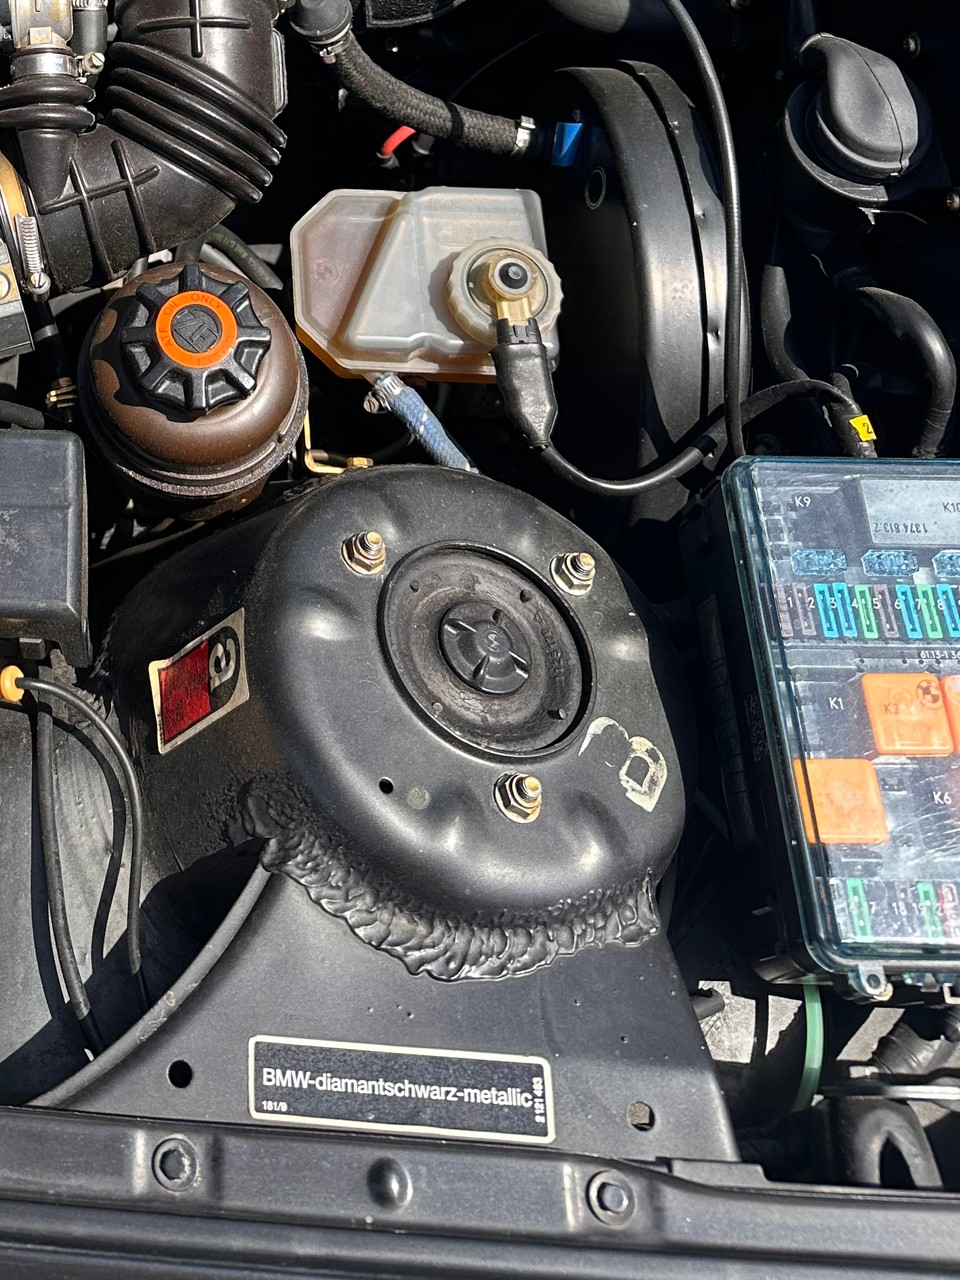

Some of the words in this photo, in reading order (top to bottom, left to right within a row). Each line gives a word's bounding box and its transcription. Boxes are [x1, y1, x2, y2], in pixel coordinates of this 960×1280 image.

[163, 298, 181, 317] OIL
[190, 292, 223, 310] ONLY
[158, 326, 174, 349] ATF
[794, 495, 812, 508] K9
[807, 597, 815, 609] 2
[872, 598, 880, 609] 5
[828, 697, 845, 710] K1
[883, 703, 900, 715] K2
[932, 791, 953, 805] K6
[261, 1066, 534, 1108] BMW-diamantschwarz-metallic
[261, 1099, 288, 1113] 181/9
